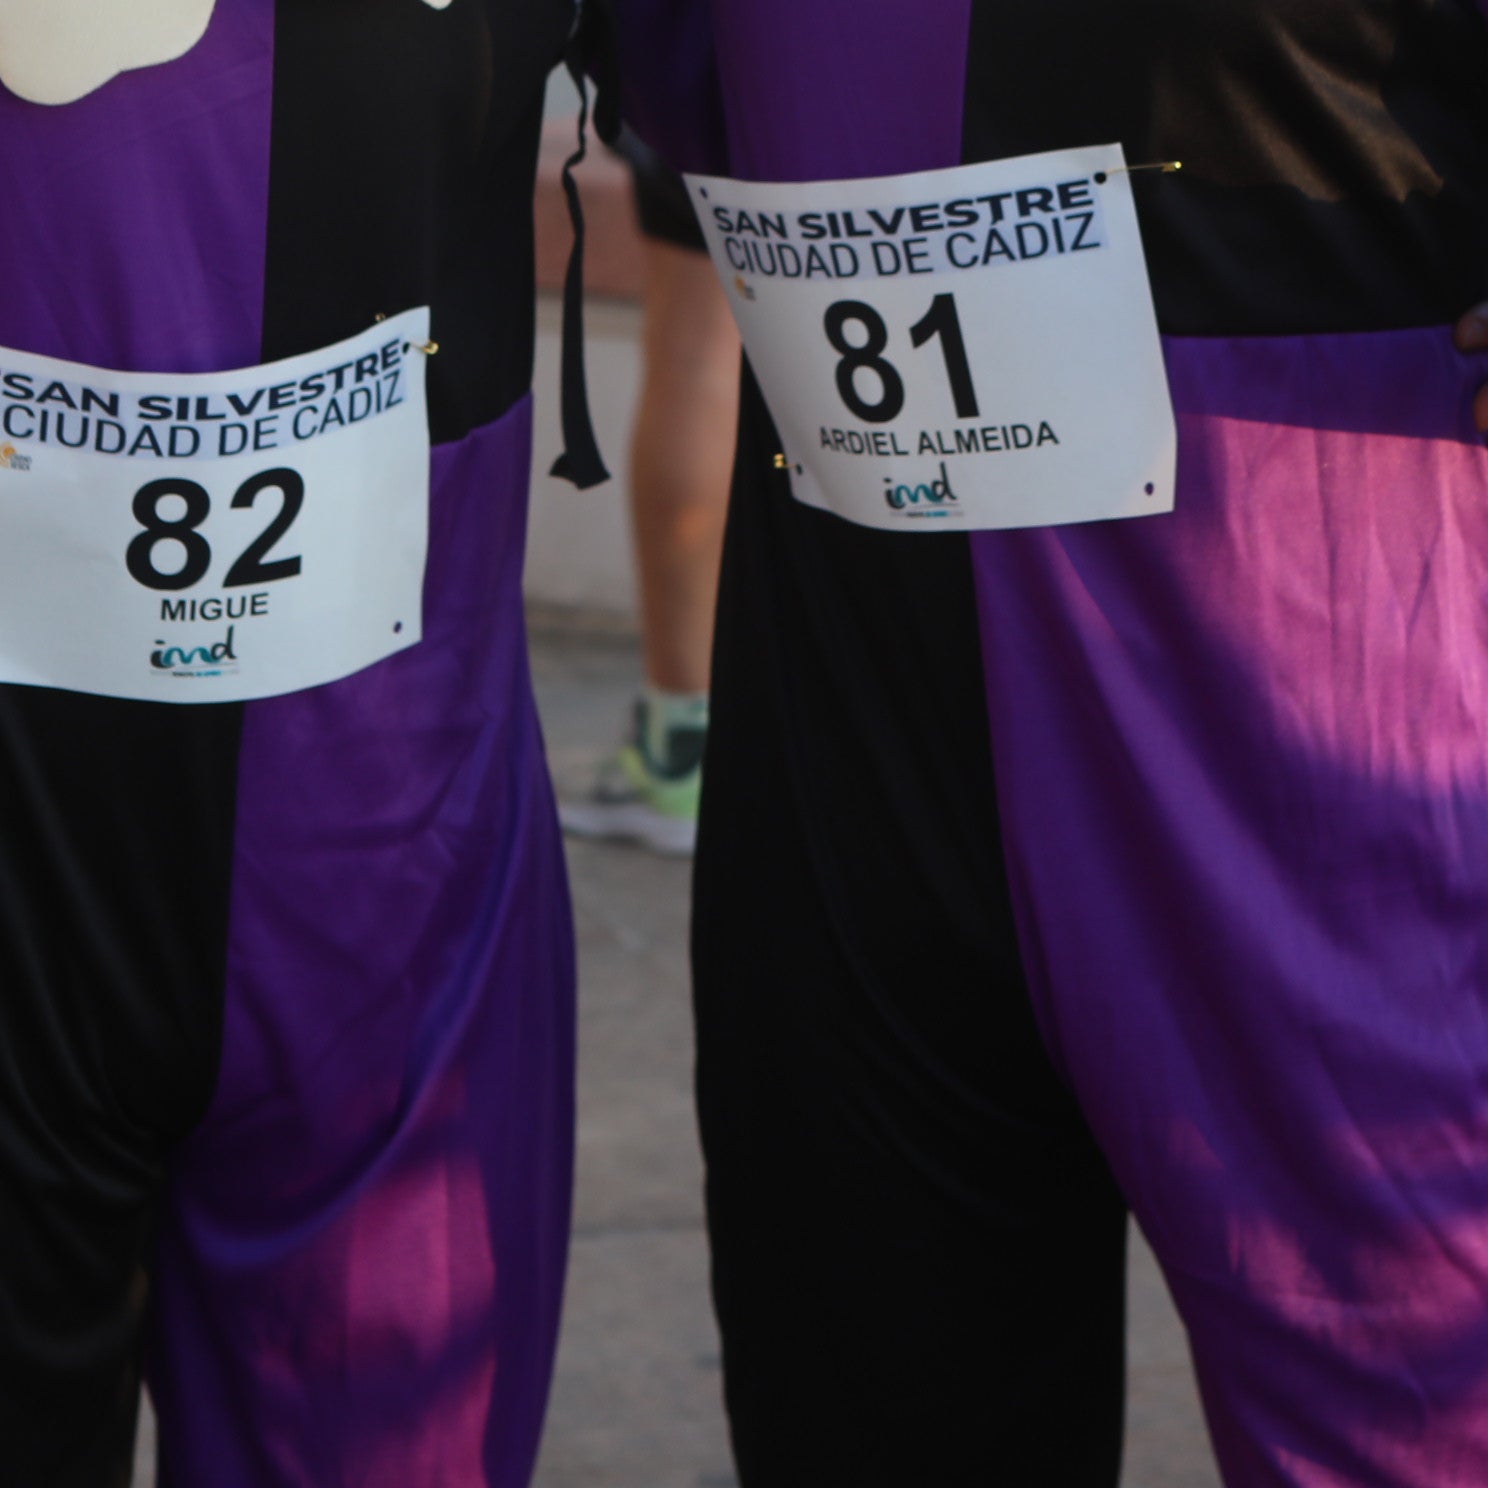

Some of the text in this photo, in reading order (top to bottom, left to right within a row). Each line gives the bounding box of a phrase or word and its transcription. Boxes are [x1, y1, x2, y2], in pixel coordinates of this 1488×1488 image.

[713, 178, 1094, 239] SAN SILVESTRE
[725, 212, 1101, 279] CIUDAD DE CÁDIZ
[2, 339, 402, 421] SAN SILVESTRE
[823, 293, 980, 423] 81
[3, 370, 403, 458] CIUDAD DE CÁDIZ
[820, 421, 1060, 456] ARDIEL ALMEIDA
[125, 467, 306, 591] 82
[160, 593, 270, 622] MIGUE
